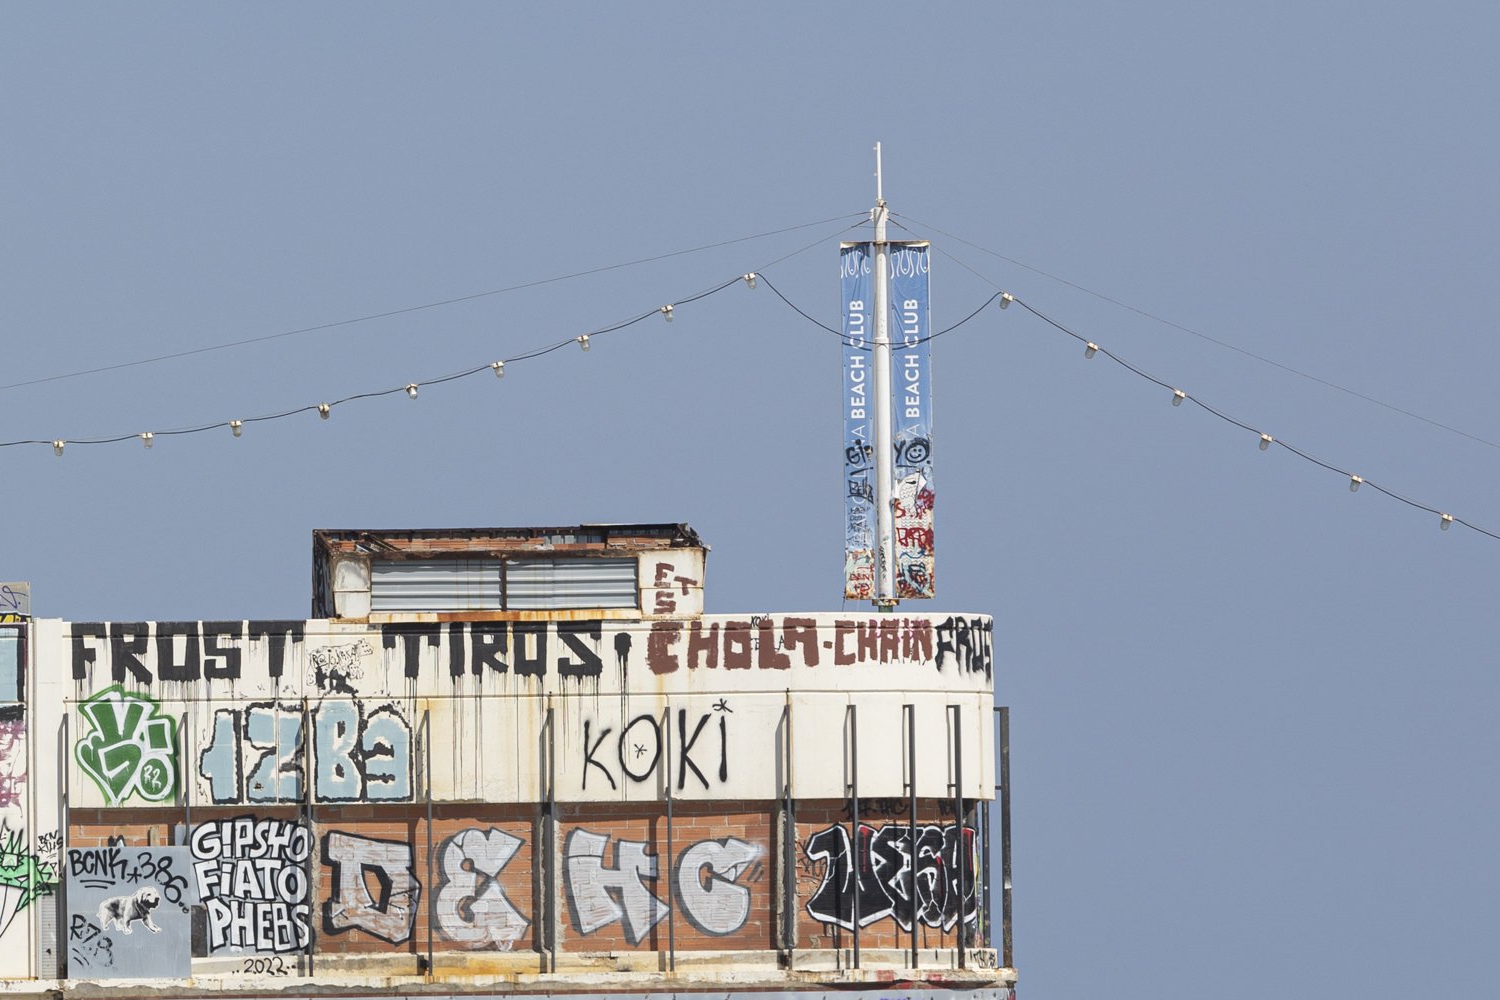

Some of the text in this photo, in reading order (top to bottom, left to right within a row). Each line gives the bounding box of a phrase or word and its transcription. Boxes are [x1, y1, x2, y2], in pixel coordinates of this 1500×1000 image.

[850, 300, 864, 349] CLUB
[851, 356, 865, 419] BEACH
[904, 299, 920, 418] BEACH CLUB
[71, 620, 306, 684] FROST
